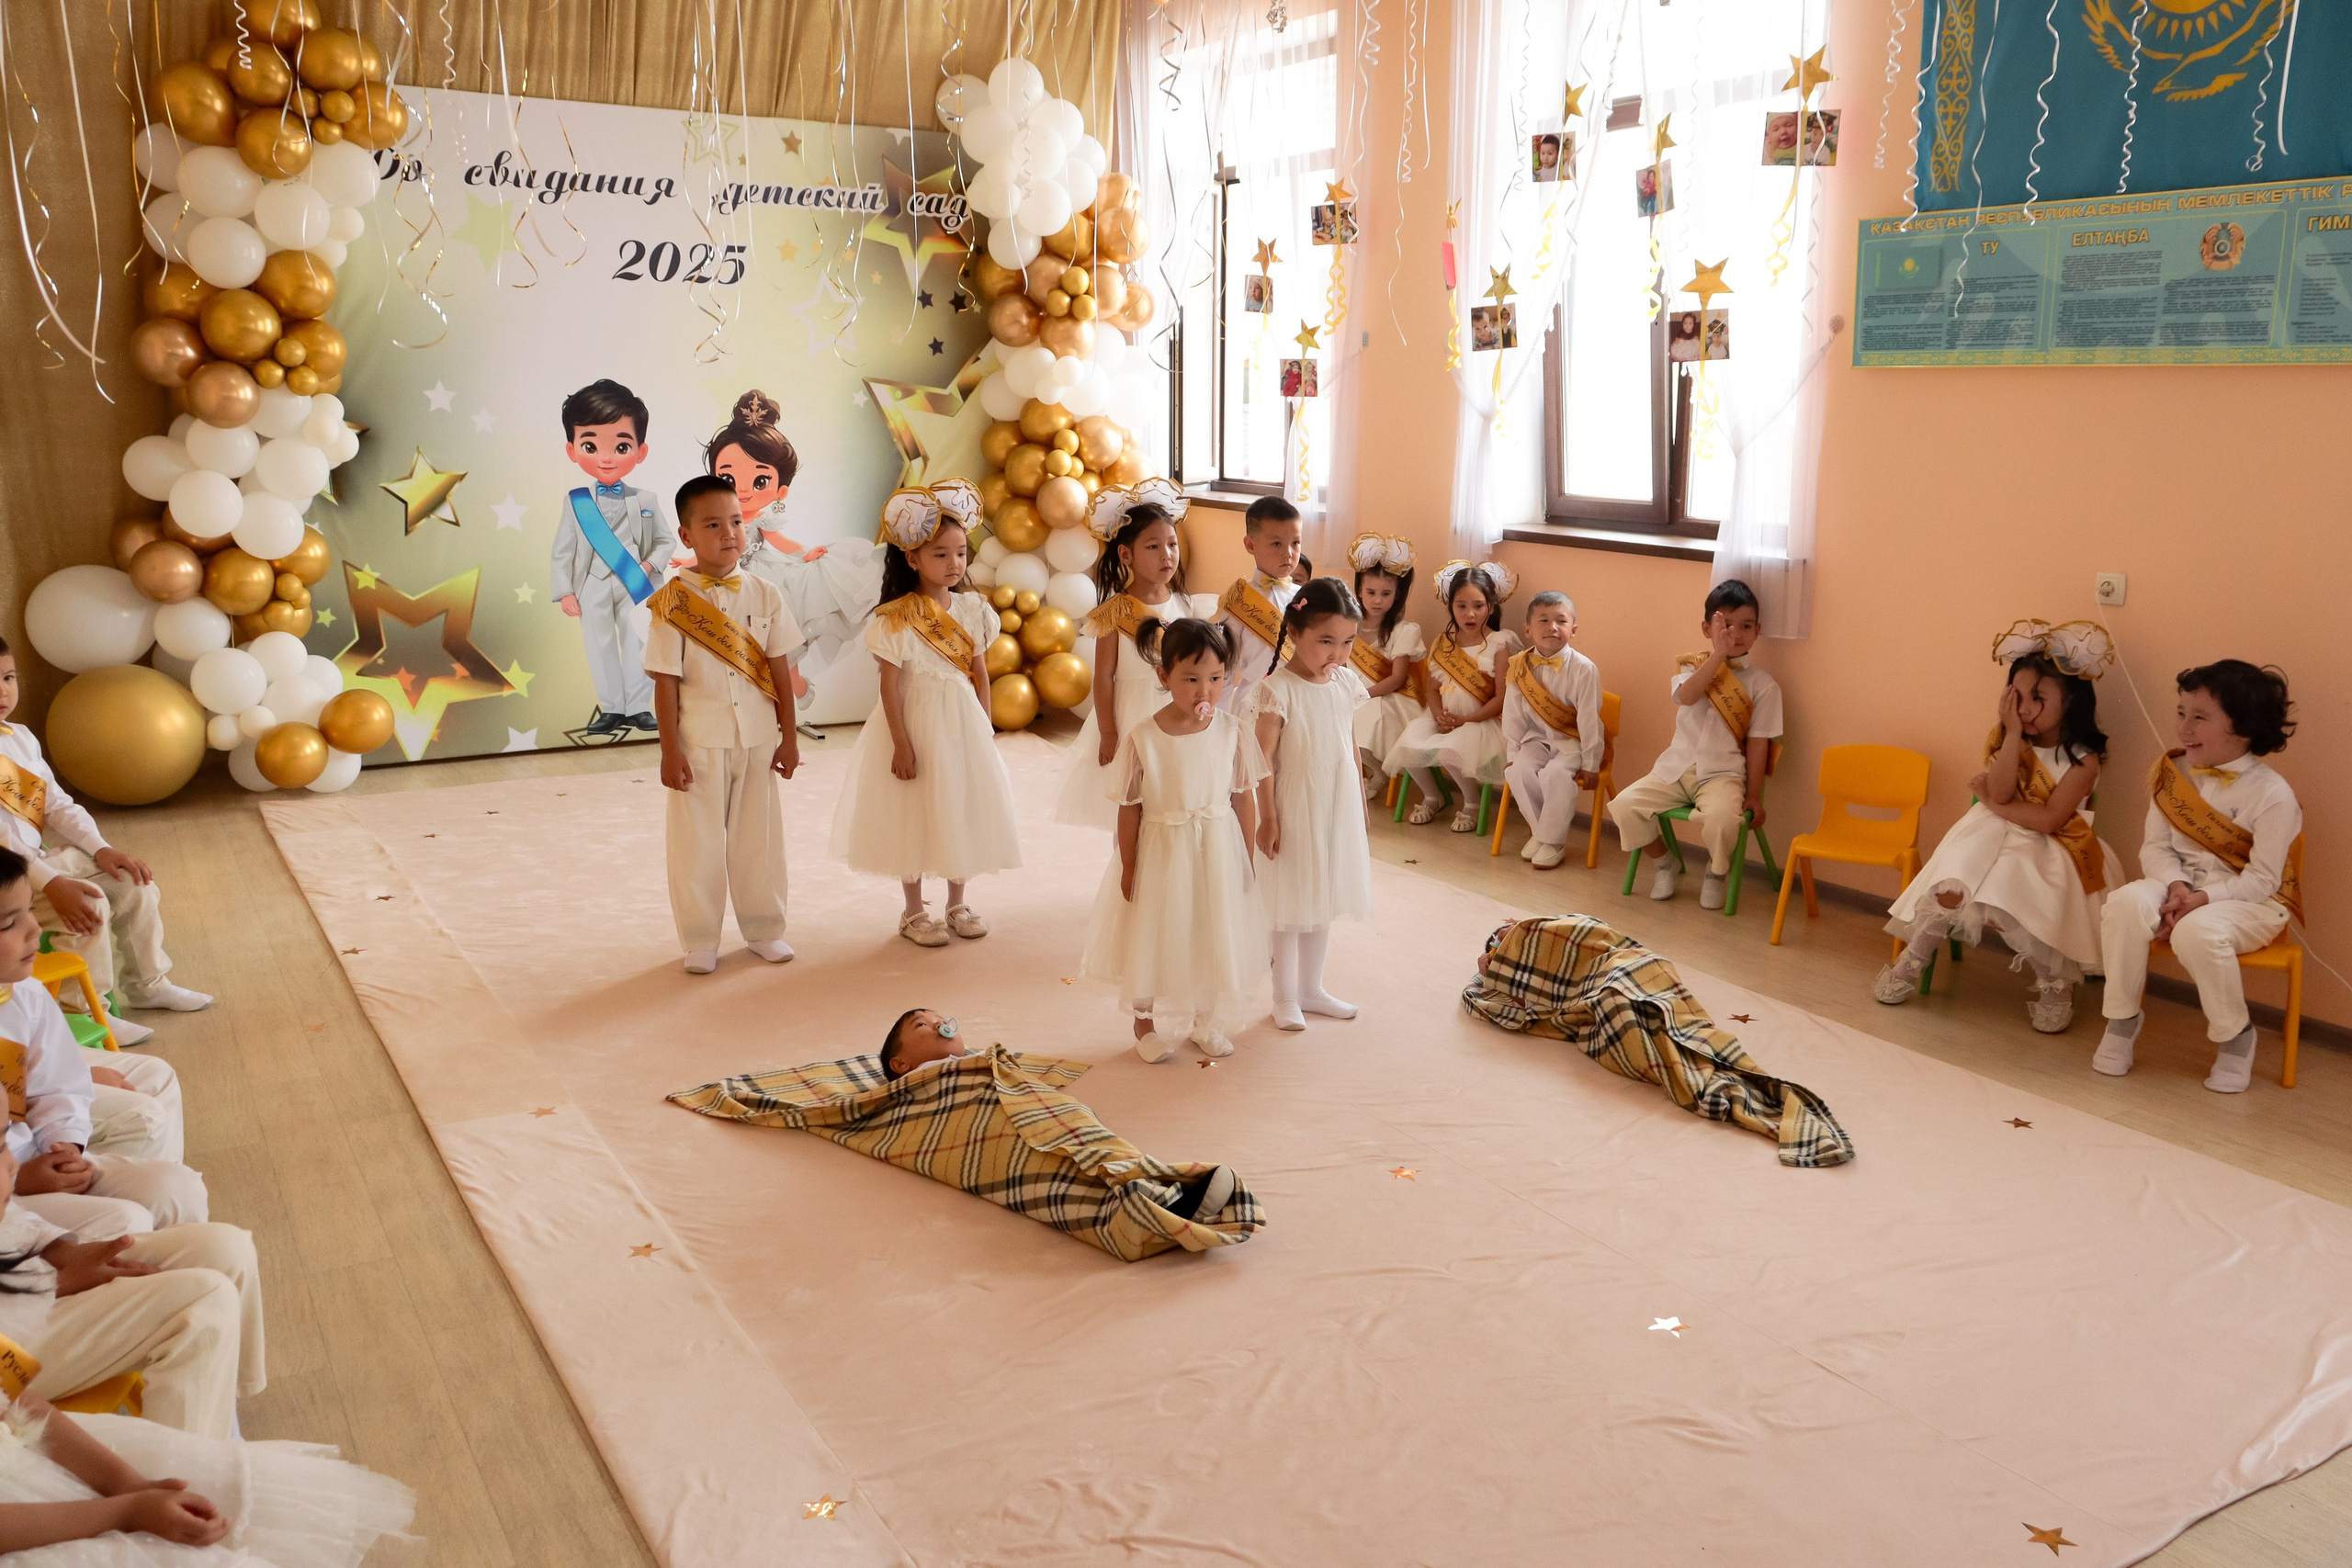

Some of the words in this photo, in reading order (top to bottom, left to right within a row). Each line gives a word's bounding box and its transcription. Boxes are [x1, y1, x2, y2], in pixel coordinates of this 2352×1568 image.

[464, 150, 678, 206] свидания
[910, 194, 969, 228] сад
[1870, 215, 1970, 236] ҚАЗАҚСТАН
[2177, 185, 2335, 210] МЕМЛЕКЕТТІК
[2308, 215, 2352, 231] ГИМ
[1981, 241, 2000, 254] ТУ
[2072, 229, 2150, 247] ЕЛТАҢБА
[612, 239, 747, 285] 2025
